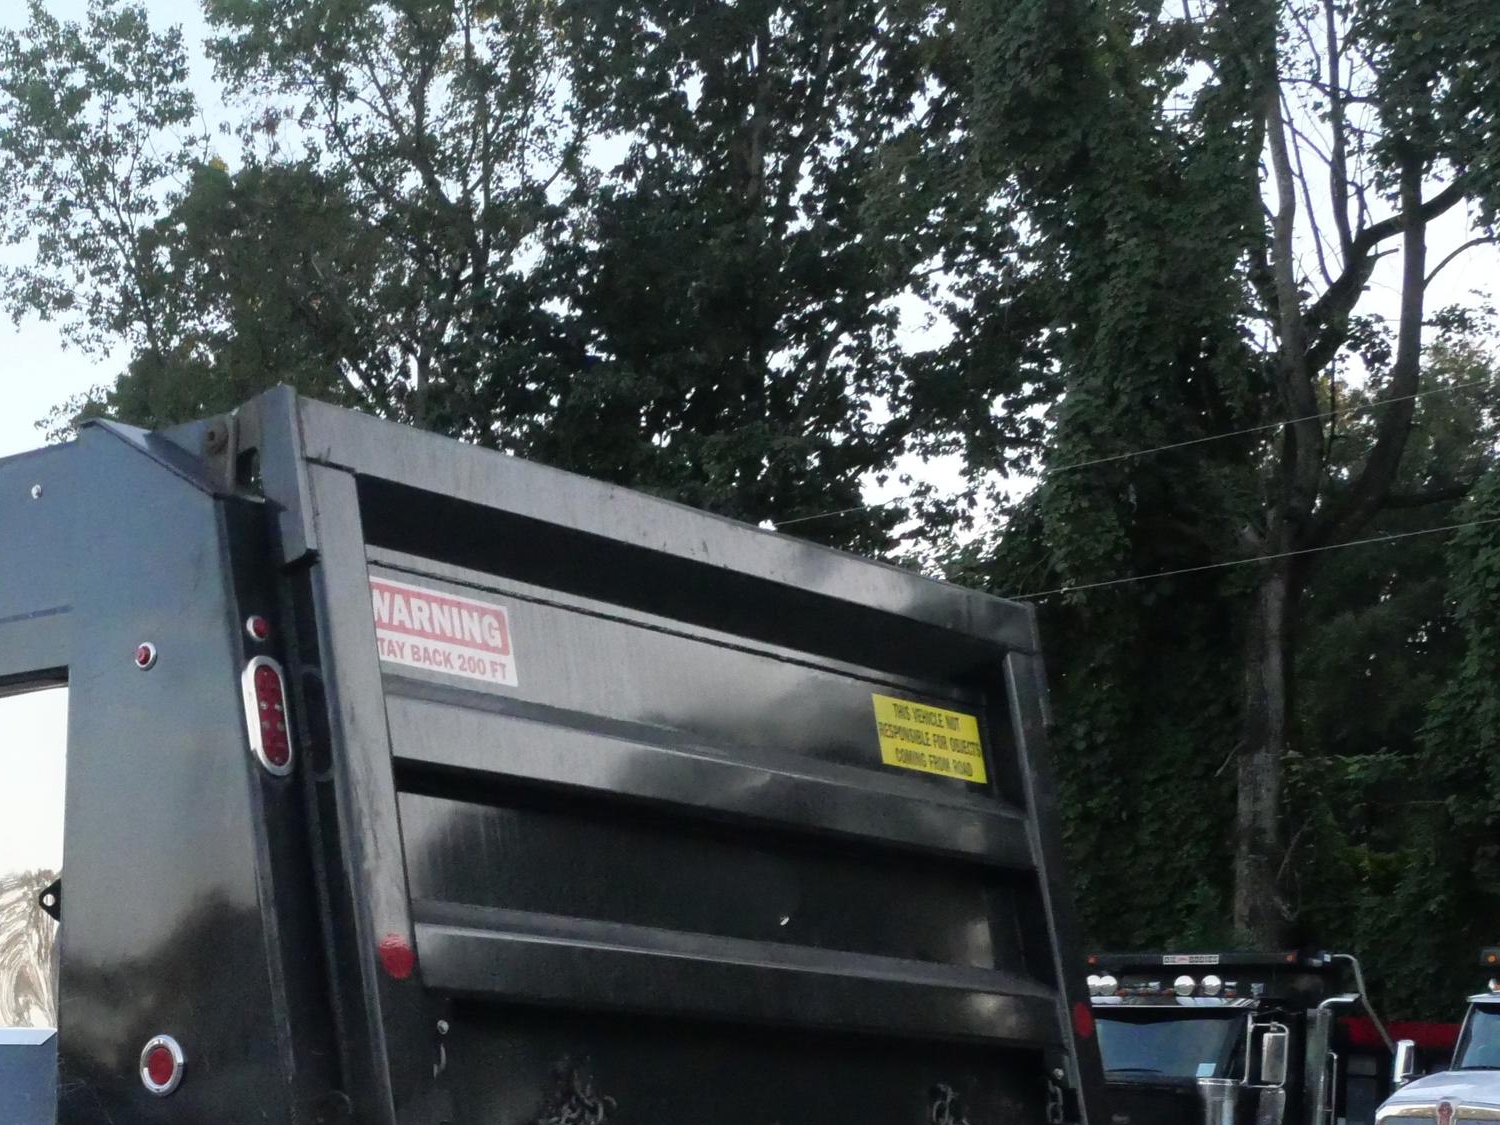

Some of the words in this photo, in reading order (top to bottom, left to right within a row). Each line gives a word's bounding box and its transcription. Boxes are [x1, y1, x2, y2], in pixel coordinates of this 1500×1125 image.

[372, 589, 502, 648] WARNING
[376, 637, 406, 660] TAY
[410, 644, 454, 670] BACK
[457, 654, 486, 676] 200
[490, 661, 507, 680] FT
